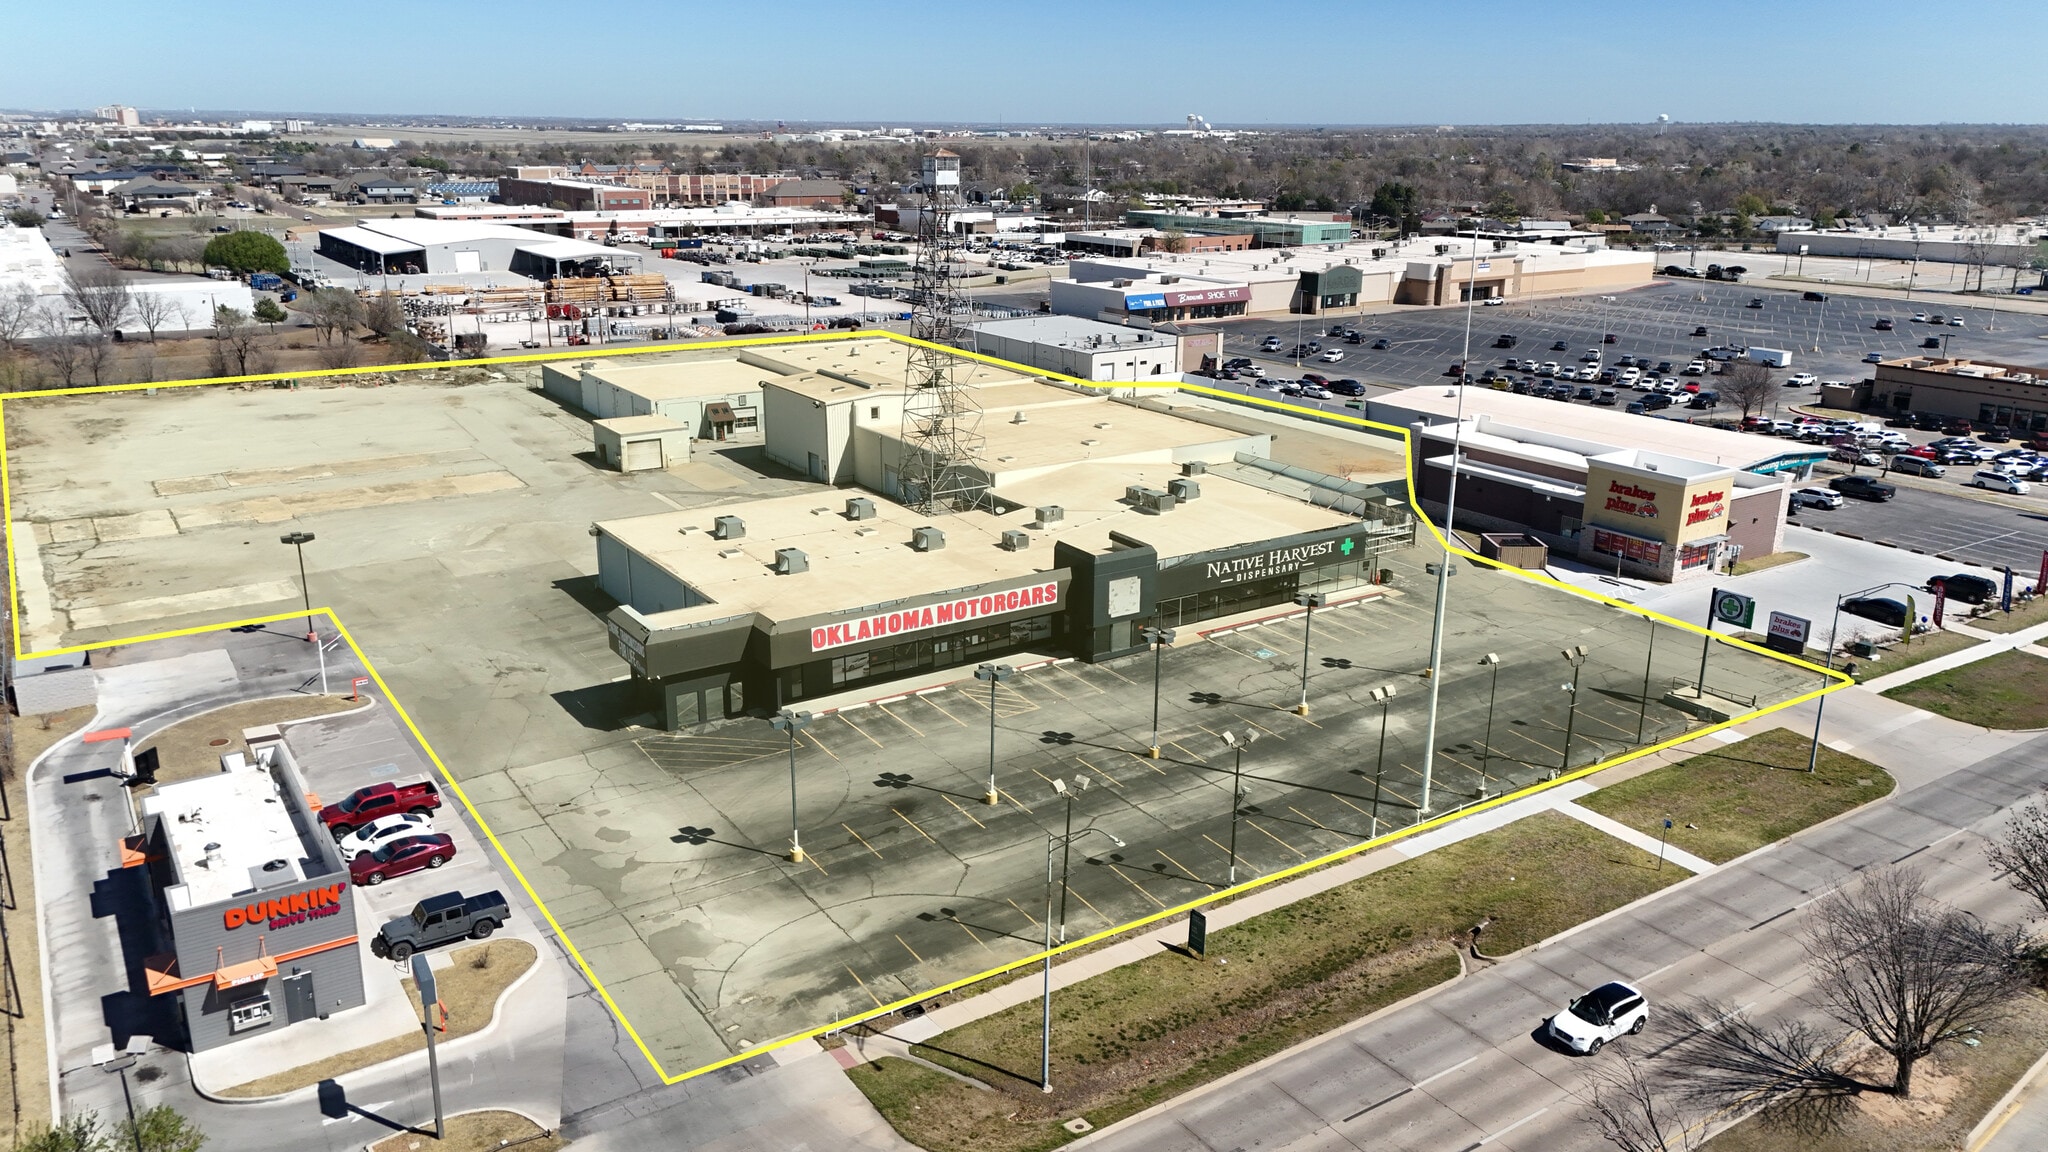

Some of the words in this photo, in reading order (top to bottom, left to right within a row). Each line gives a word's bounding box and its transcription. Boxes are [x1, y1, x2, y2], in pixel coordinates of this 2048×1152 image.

[1207, 290, 1226, 300] SHOE
[1229, 289, 1239, 298] FIT
[1609, 480, 1656, 501] brakes
[1690, 490, 1724, 507] brakes
[1604, 496, 1637, 513] plus
[1686, 508, 1710, 526] plus
[1207, 554, 1264, 579] NATIVE
[1269, 541, 1335, 567] HARVEST
[1236, 561, 1299, 582] DISPENSARY
[812, 607, 934, 649] OKLAHOMA
[937, 584, 1056, 624] MOTORCARS
[1774, 616, 1801, 628] brakes
[1771, 625, 1791, 635] plus
[224, 882, 346, 931] DUNKIN'
[269, 912, 306, 931] DRIVE
[307, 904, 341, 921] THRU
[231, 975, 251, 987] PICK
[252, 972, 265, 982] UP
